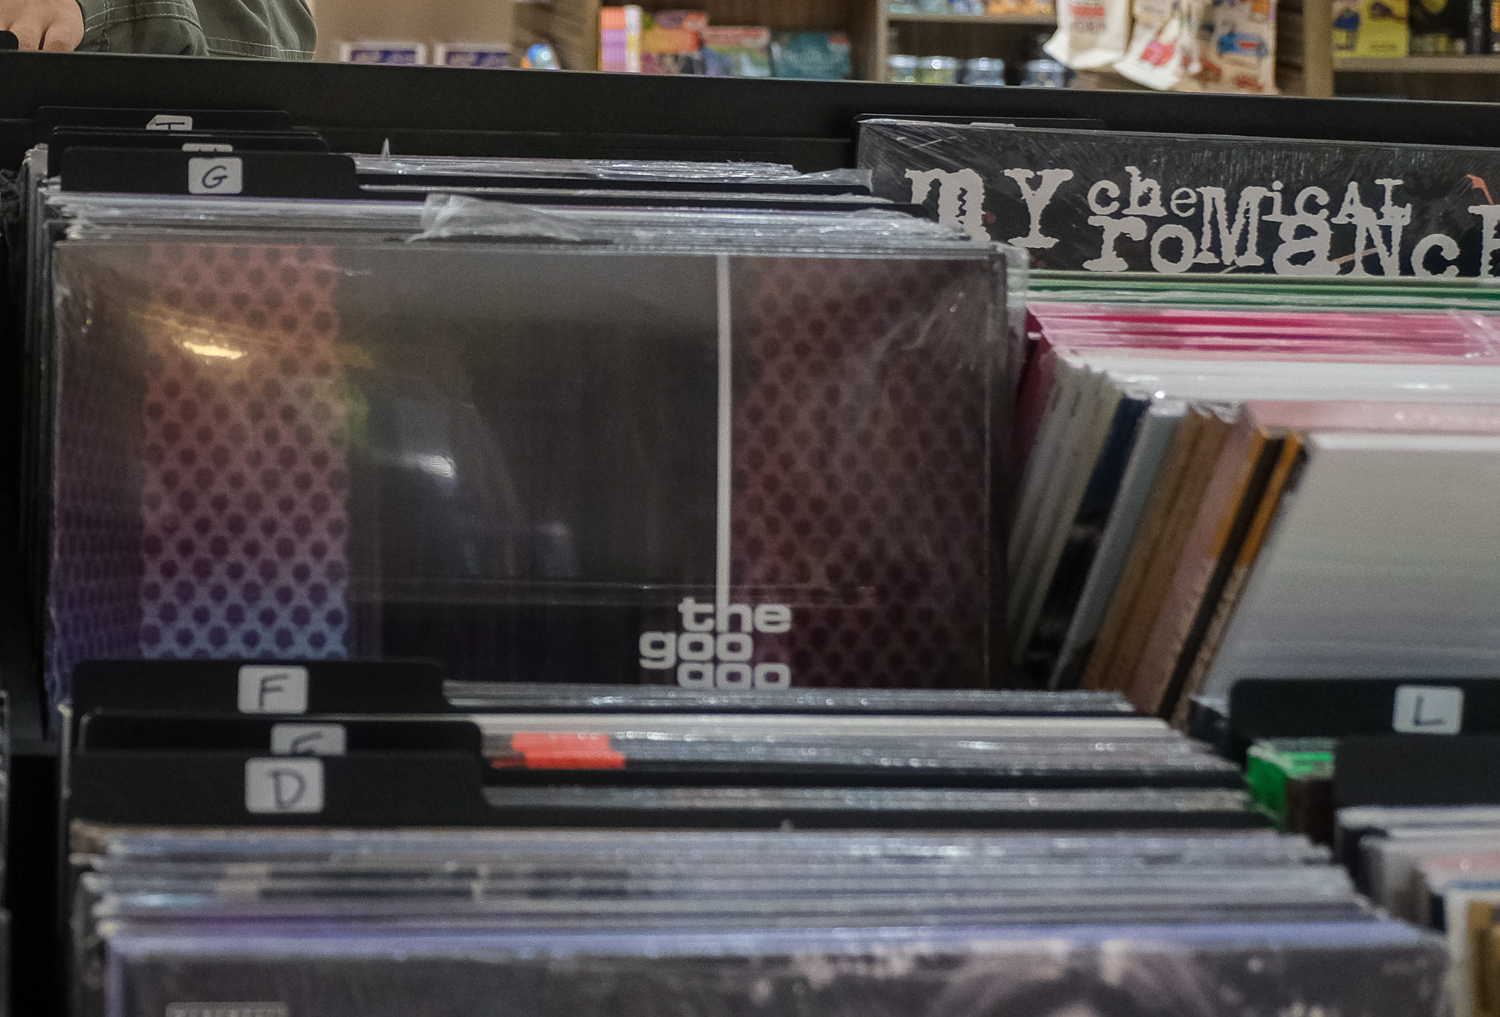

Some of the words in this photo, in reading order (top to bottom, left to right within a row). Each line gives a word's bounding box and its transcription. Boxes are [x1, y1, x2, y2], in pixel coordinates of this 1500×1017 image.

[202, 165, 228, 189] G
[677, 596, 792, 632] the
[638, 631, 754, 670] goo
[259, 672, 289, 709] F
[1413, 695, 1445, 726] L
[270, 768, 308, 812] D
